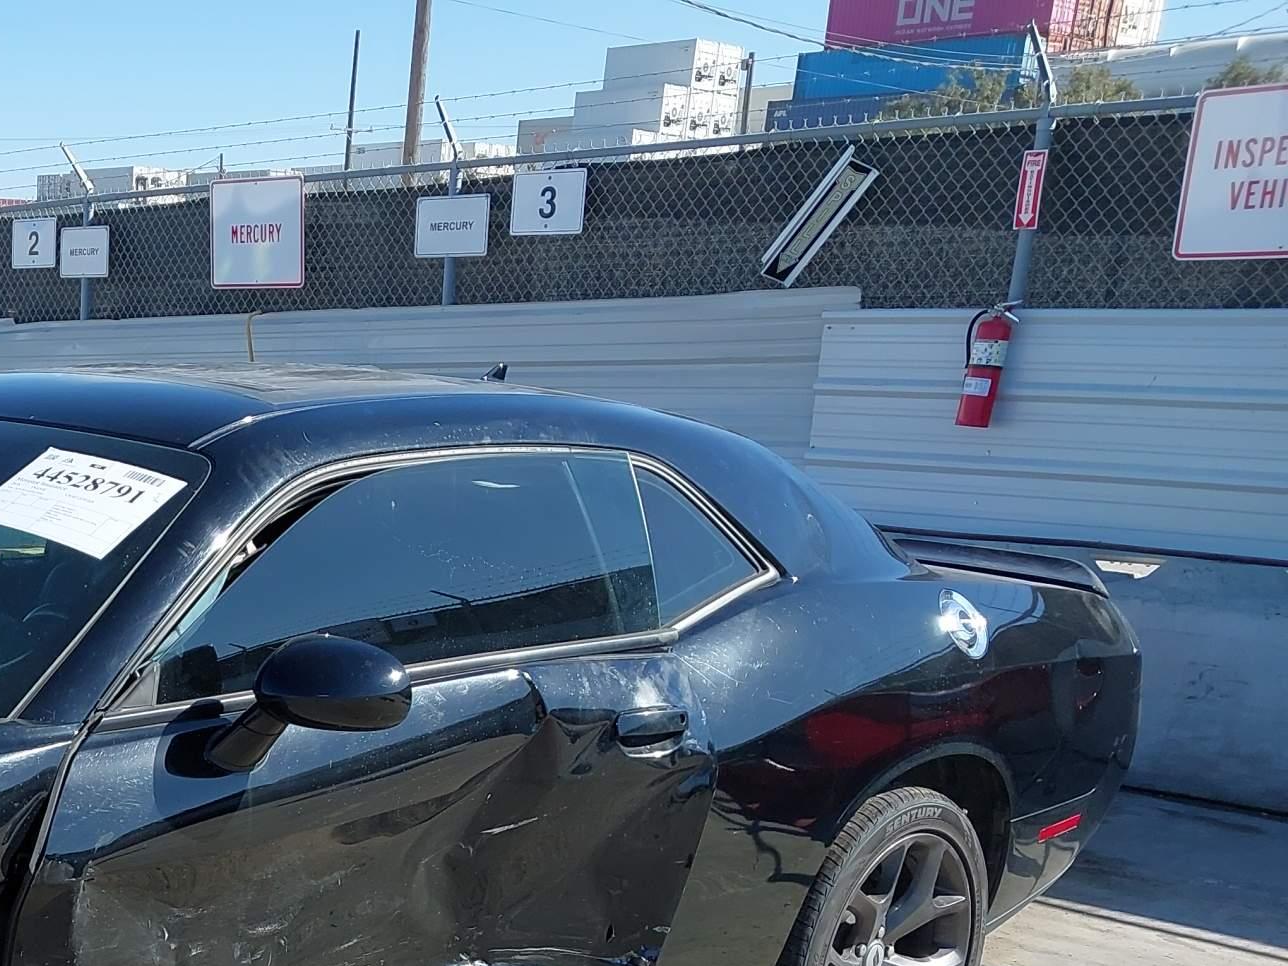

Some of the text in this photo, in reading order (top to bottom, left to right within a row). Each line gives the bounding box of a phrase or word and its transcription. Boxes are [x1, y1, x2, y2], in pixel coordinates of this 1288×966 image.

[896, 0, 975, 26] ONE
[1214, 136, 1288, 170] INSPE
[538, 186, 557, 219] 3
[1230, 180, 1288, 210] VEHI
[230, 223, 282, 244] MERCURY
[430, 220, 475, 232] MERCURY
[28, 231, 40, 256] 2
[69, 247, 99, 257] MERCURY
[33, 467, 145, 504] 44528791
